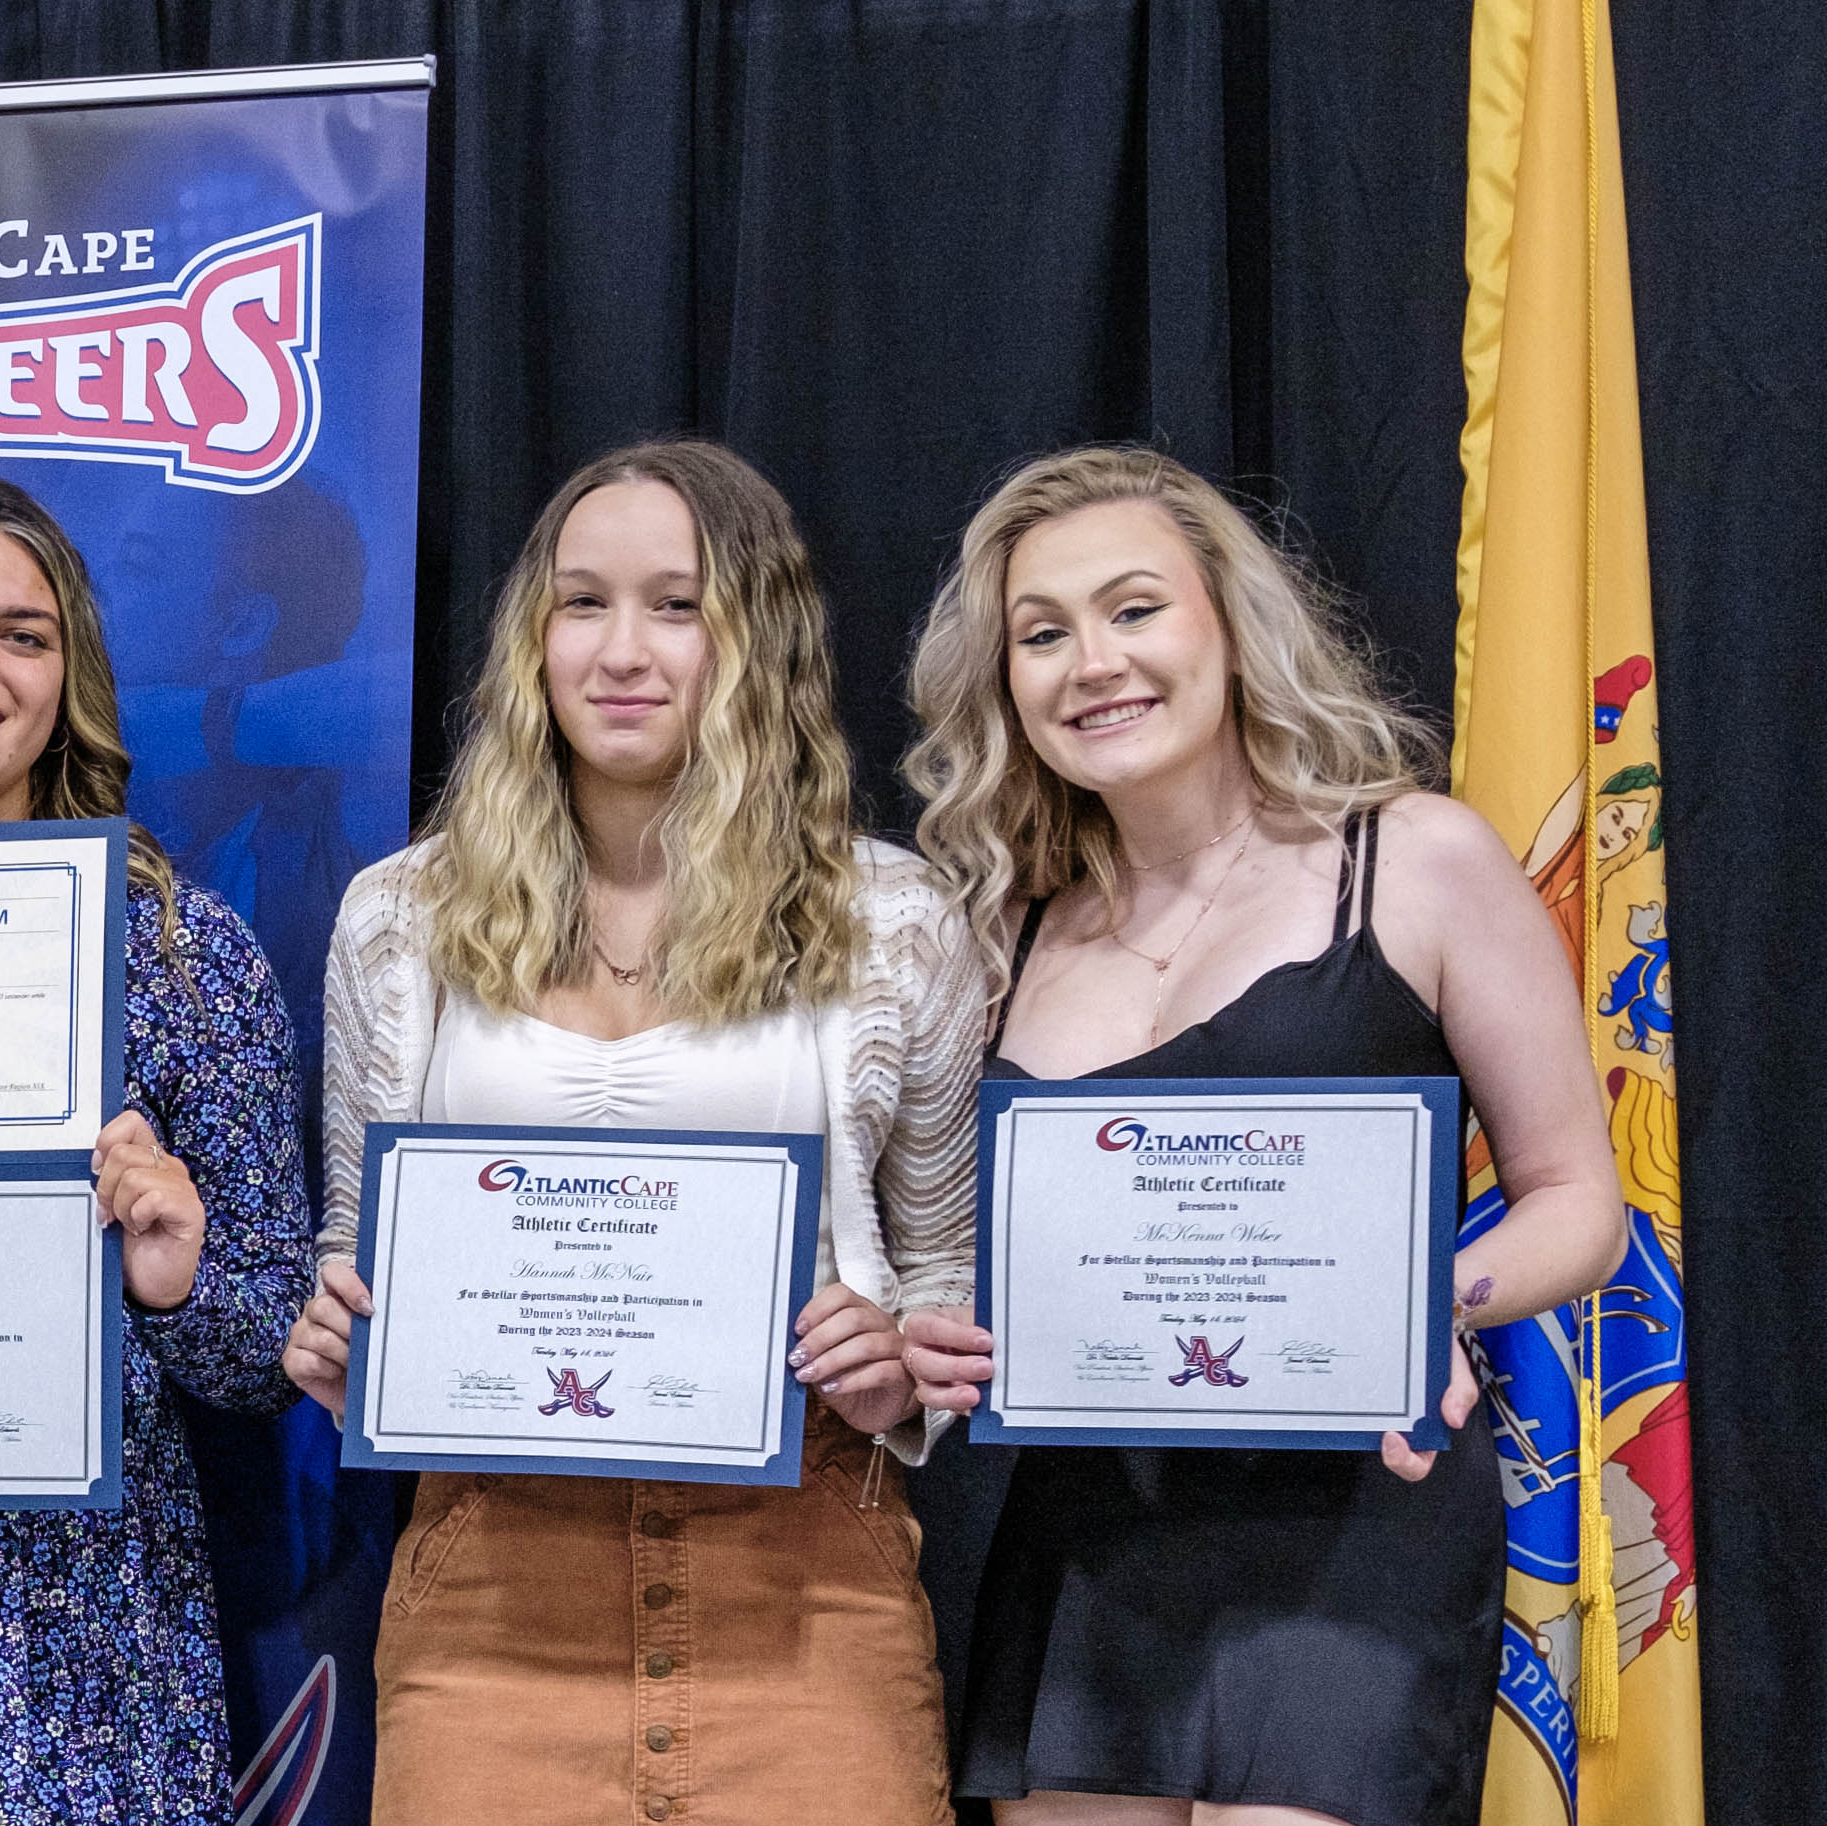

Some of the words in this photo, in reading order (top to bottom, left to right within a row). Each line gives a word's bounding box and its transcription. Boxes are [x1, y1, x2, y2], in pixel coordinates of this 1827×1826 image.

[1136, 1154, 1233, 1167] COMMUNITY
[1238, 1154, 1305, 1166] COLLEGE
[1132, 1176, 1195, 1193] Athletic
[1200, 1176, 1287, 1192] Certificate
[515, 1195, 608, 1208] COMMUNITY
[614, 1198, 678, 1211] COLLEGE
[511, 1215, 572, 1233] Athletic
[577, 1217, 658, 1235] Certificate
[1232, 1221, 1283, 1242] Weber
[510, 1261, 576, 1280] Hannah
[580, 1262, 654, 1283] McNair
[1204, 1273, 1266, 1287] Volleyball
[519, 1307, 573, 1321] Women's
[576, 1308, 635, 1324] Volleyball
